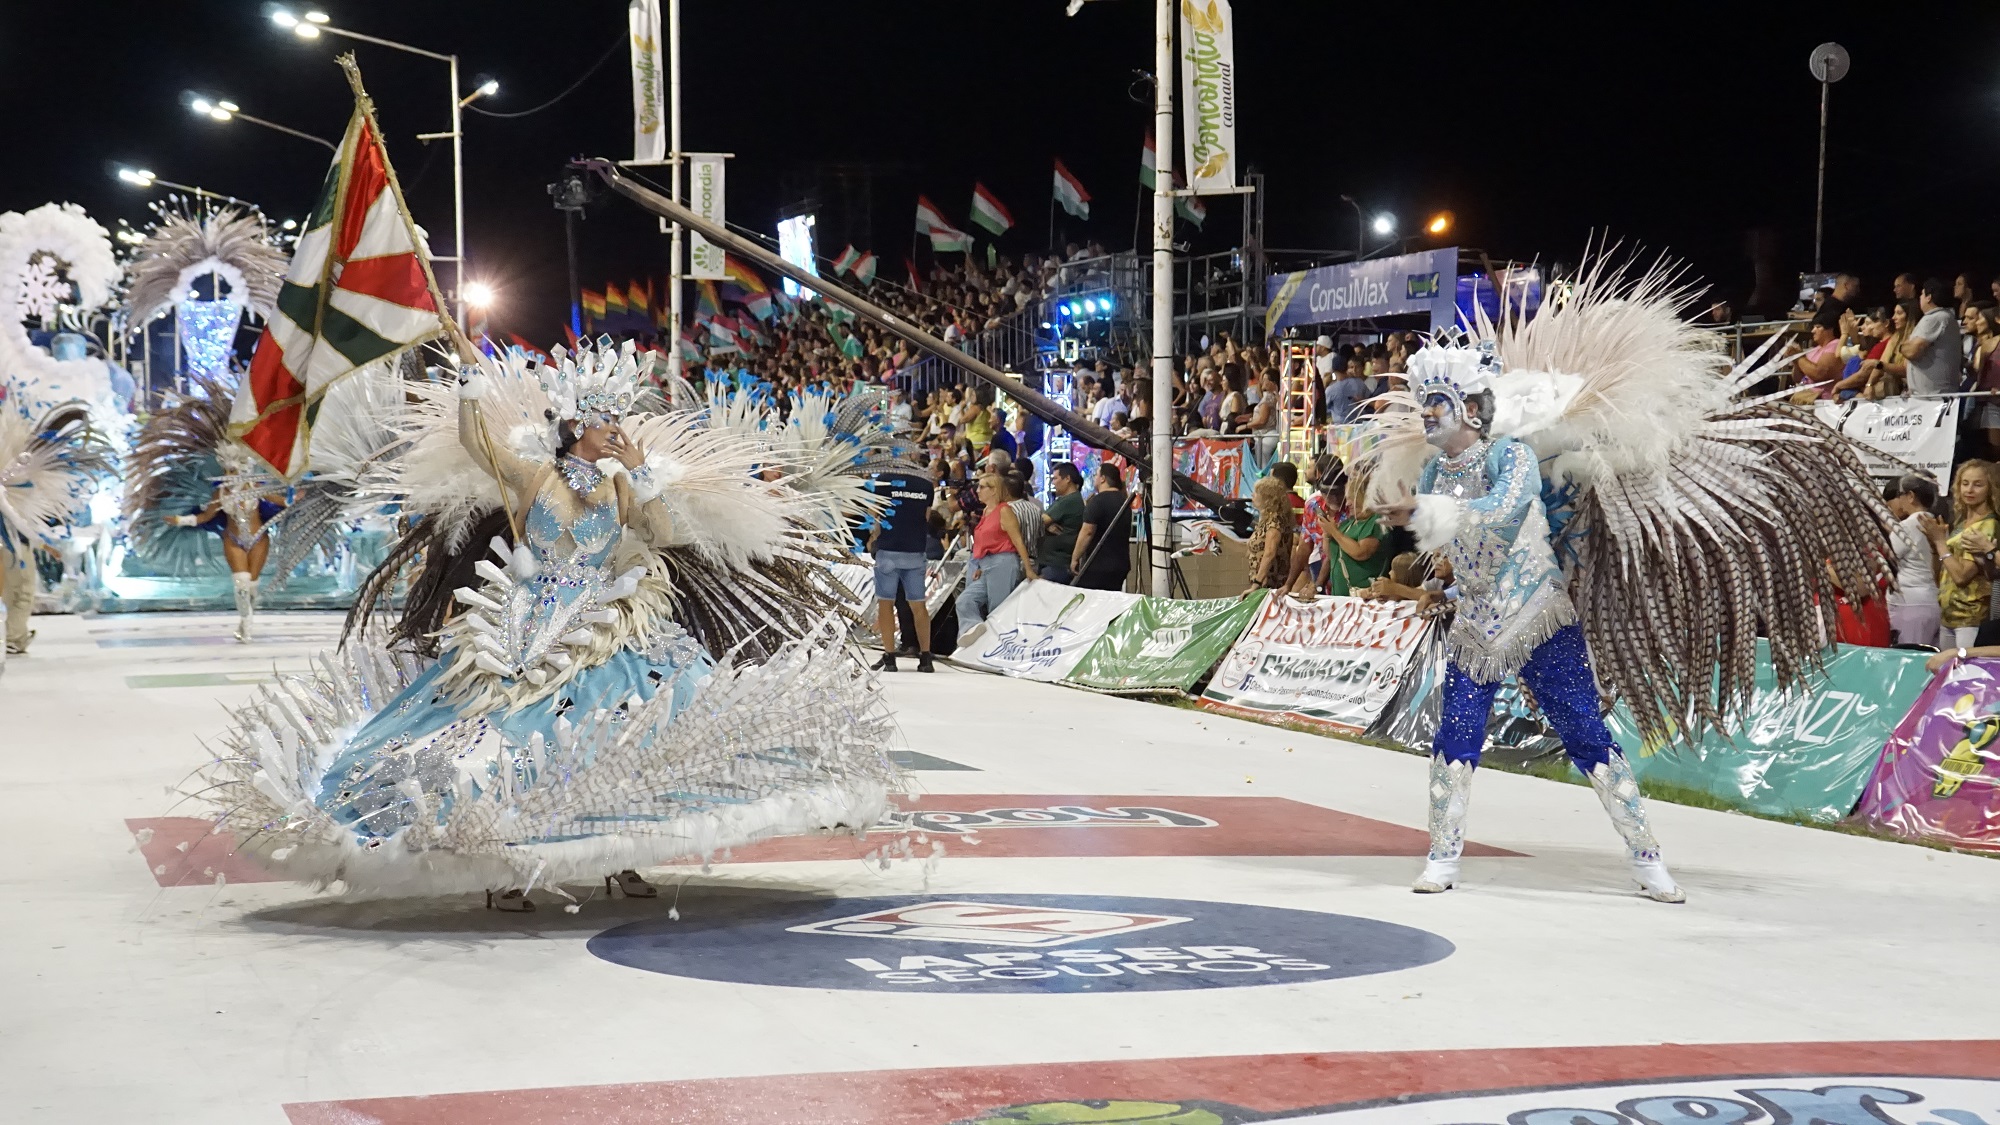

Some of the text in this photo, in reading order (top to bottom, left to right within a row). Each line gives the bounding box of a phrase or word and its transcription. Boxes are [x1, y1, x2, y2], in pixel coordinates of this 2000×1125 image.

[1217, 61, 1234, 128] carnaval
[699, 163, 713, 222] ncordia
[1309, 276, 1389, 313] ConsuMax
[1260, 654, 1371, 684] CHACINADOS
[845, 945, 1288, 972] IAPSER
[874, 959, 1332, 985] SEGUROS
